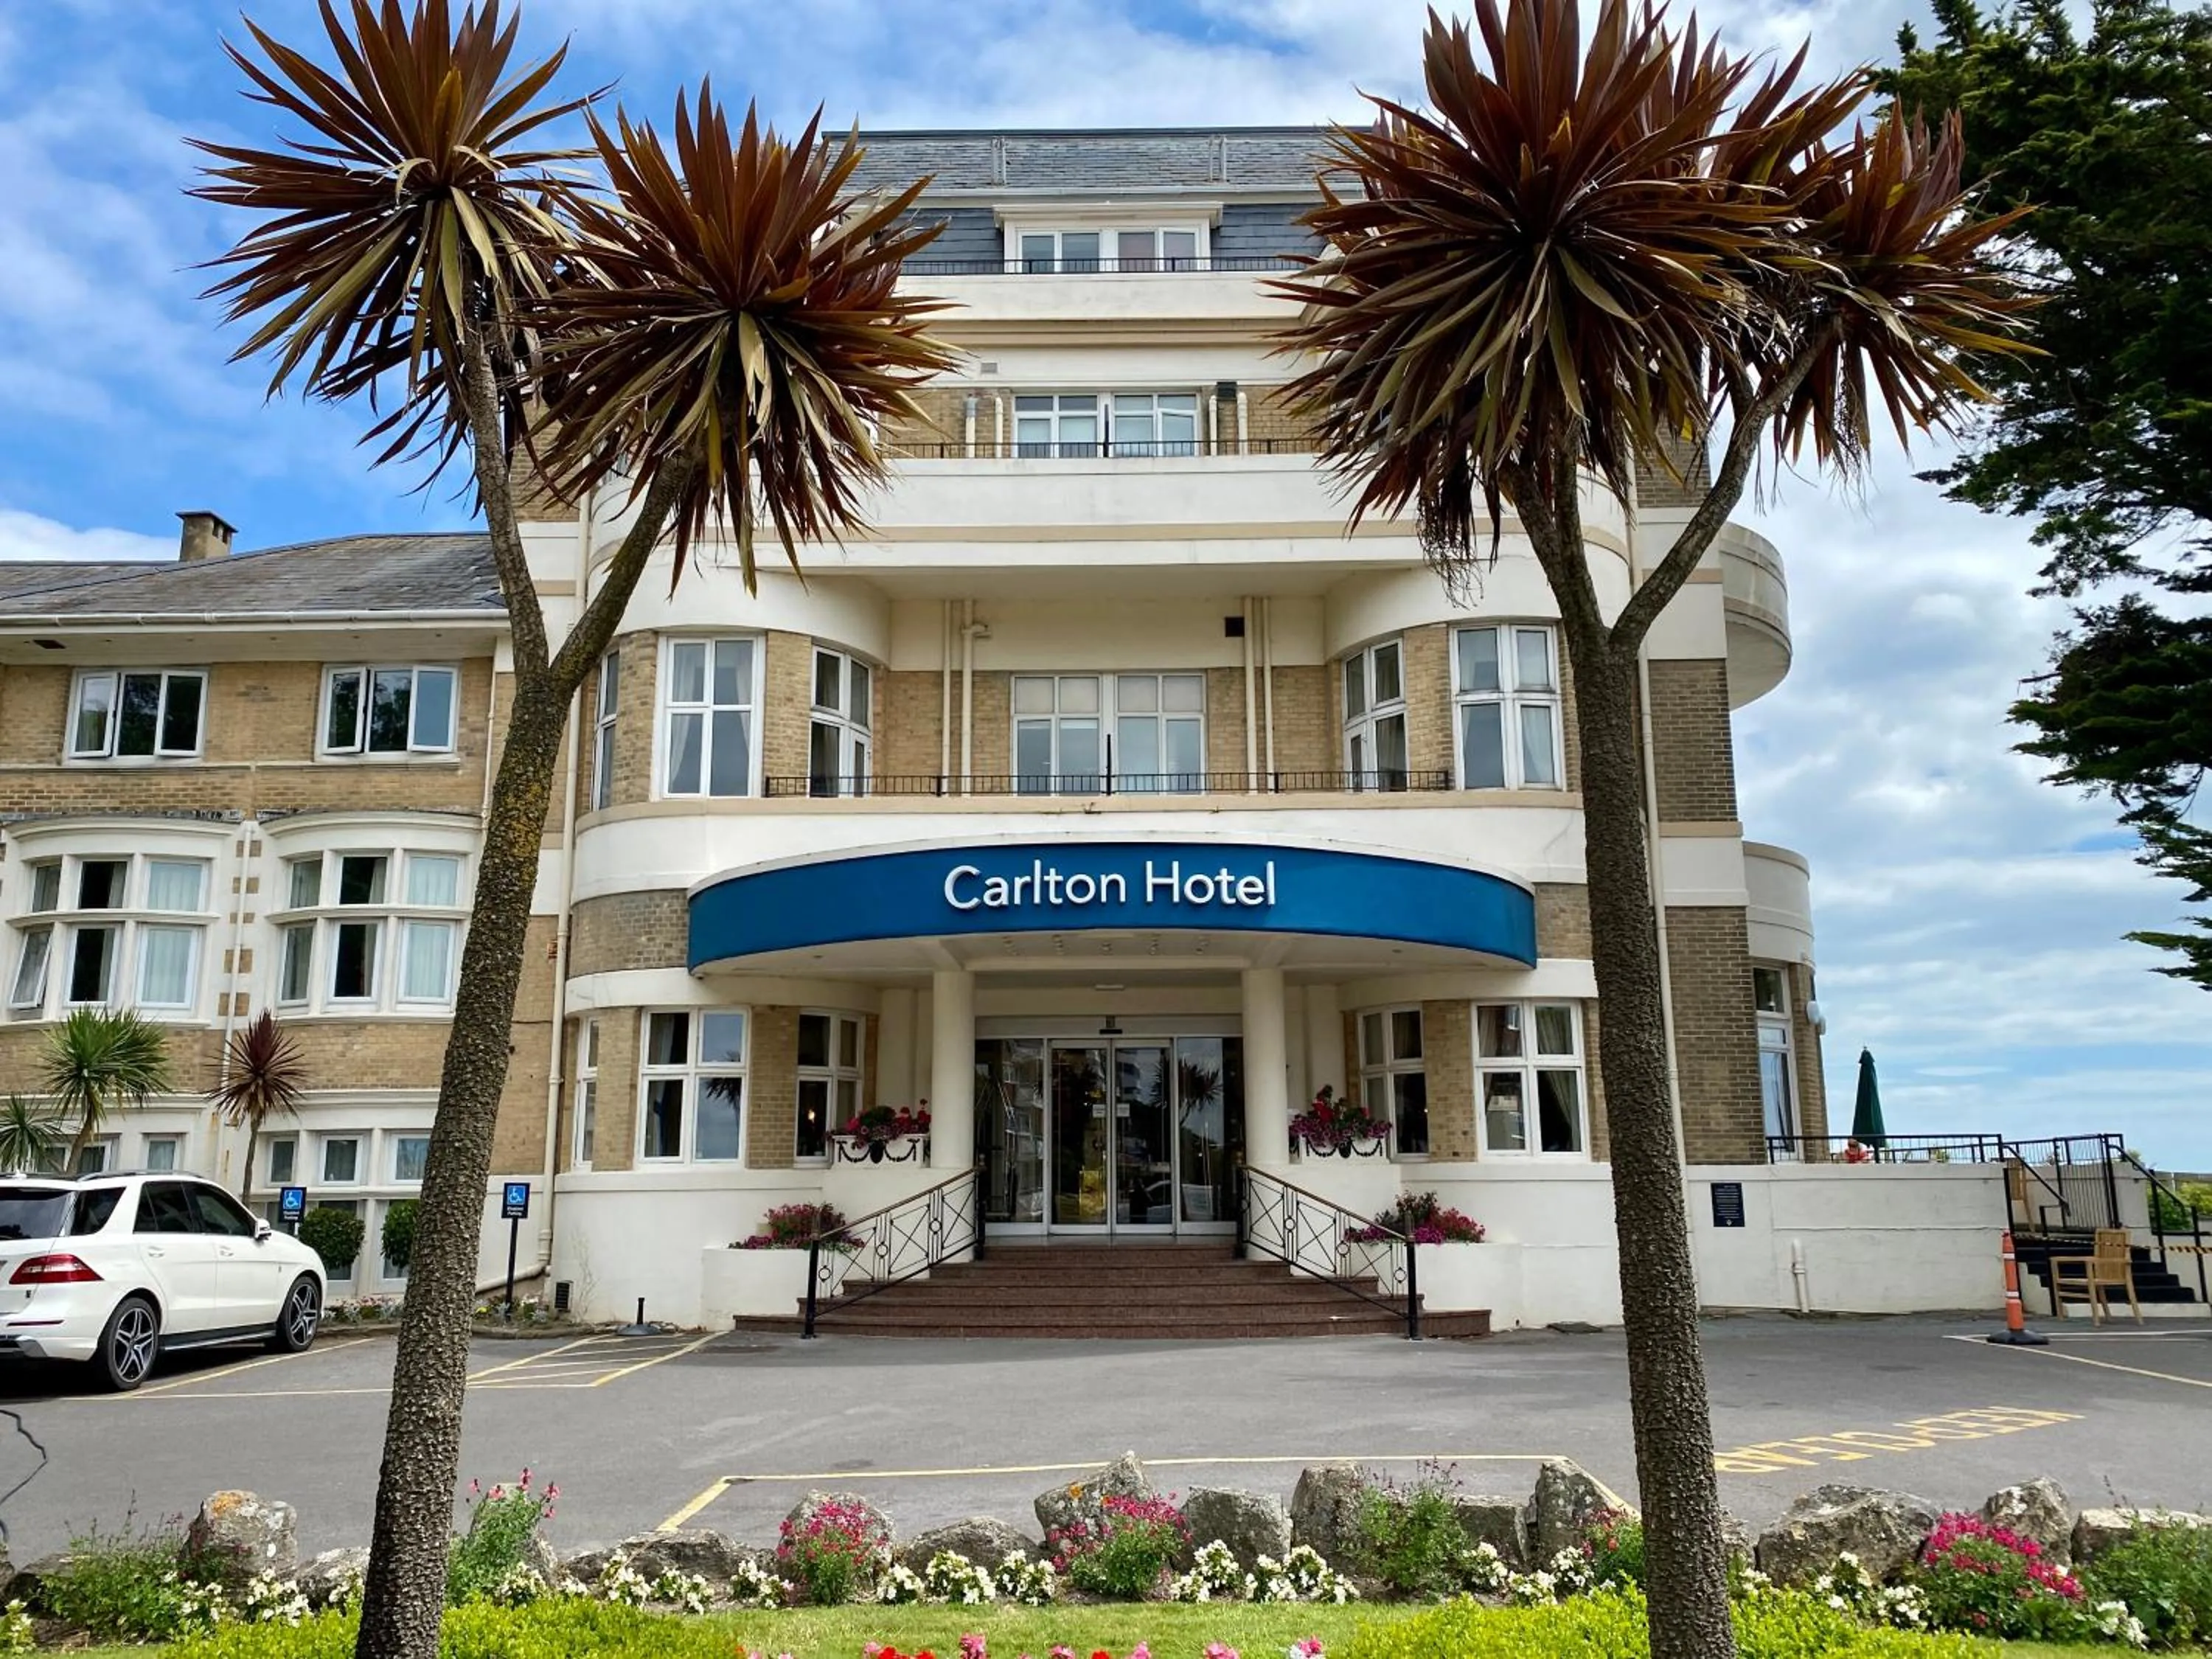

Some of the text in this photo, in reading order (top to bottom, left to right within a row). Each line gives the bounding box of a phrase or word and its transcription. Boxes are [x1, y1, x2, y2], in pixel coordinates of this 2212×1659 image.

[945, 860, 1276, 910] Carlton Hotel
[1893, 1406, 2086, 1439] KEEP
